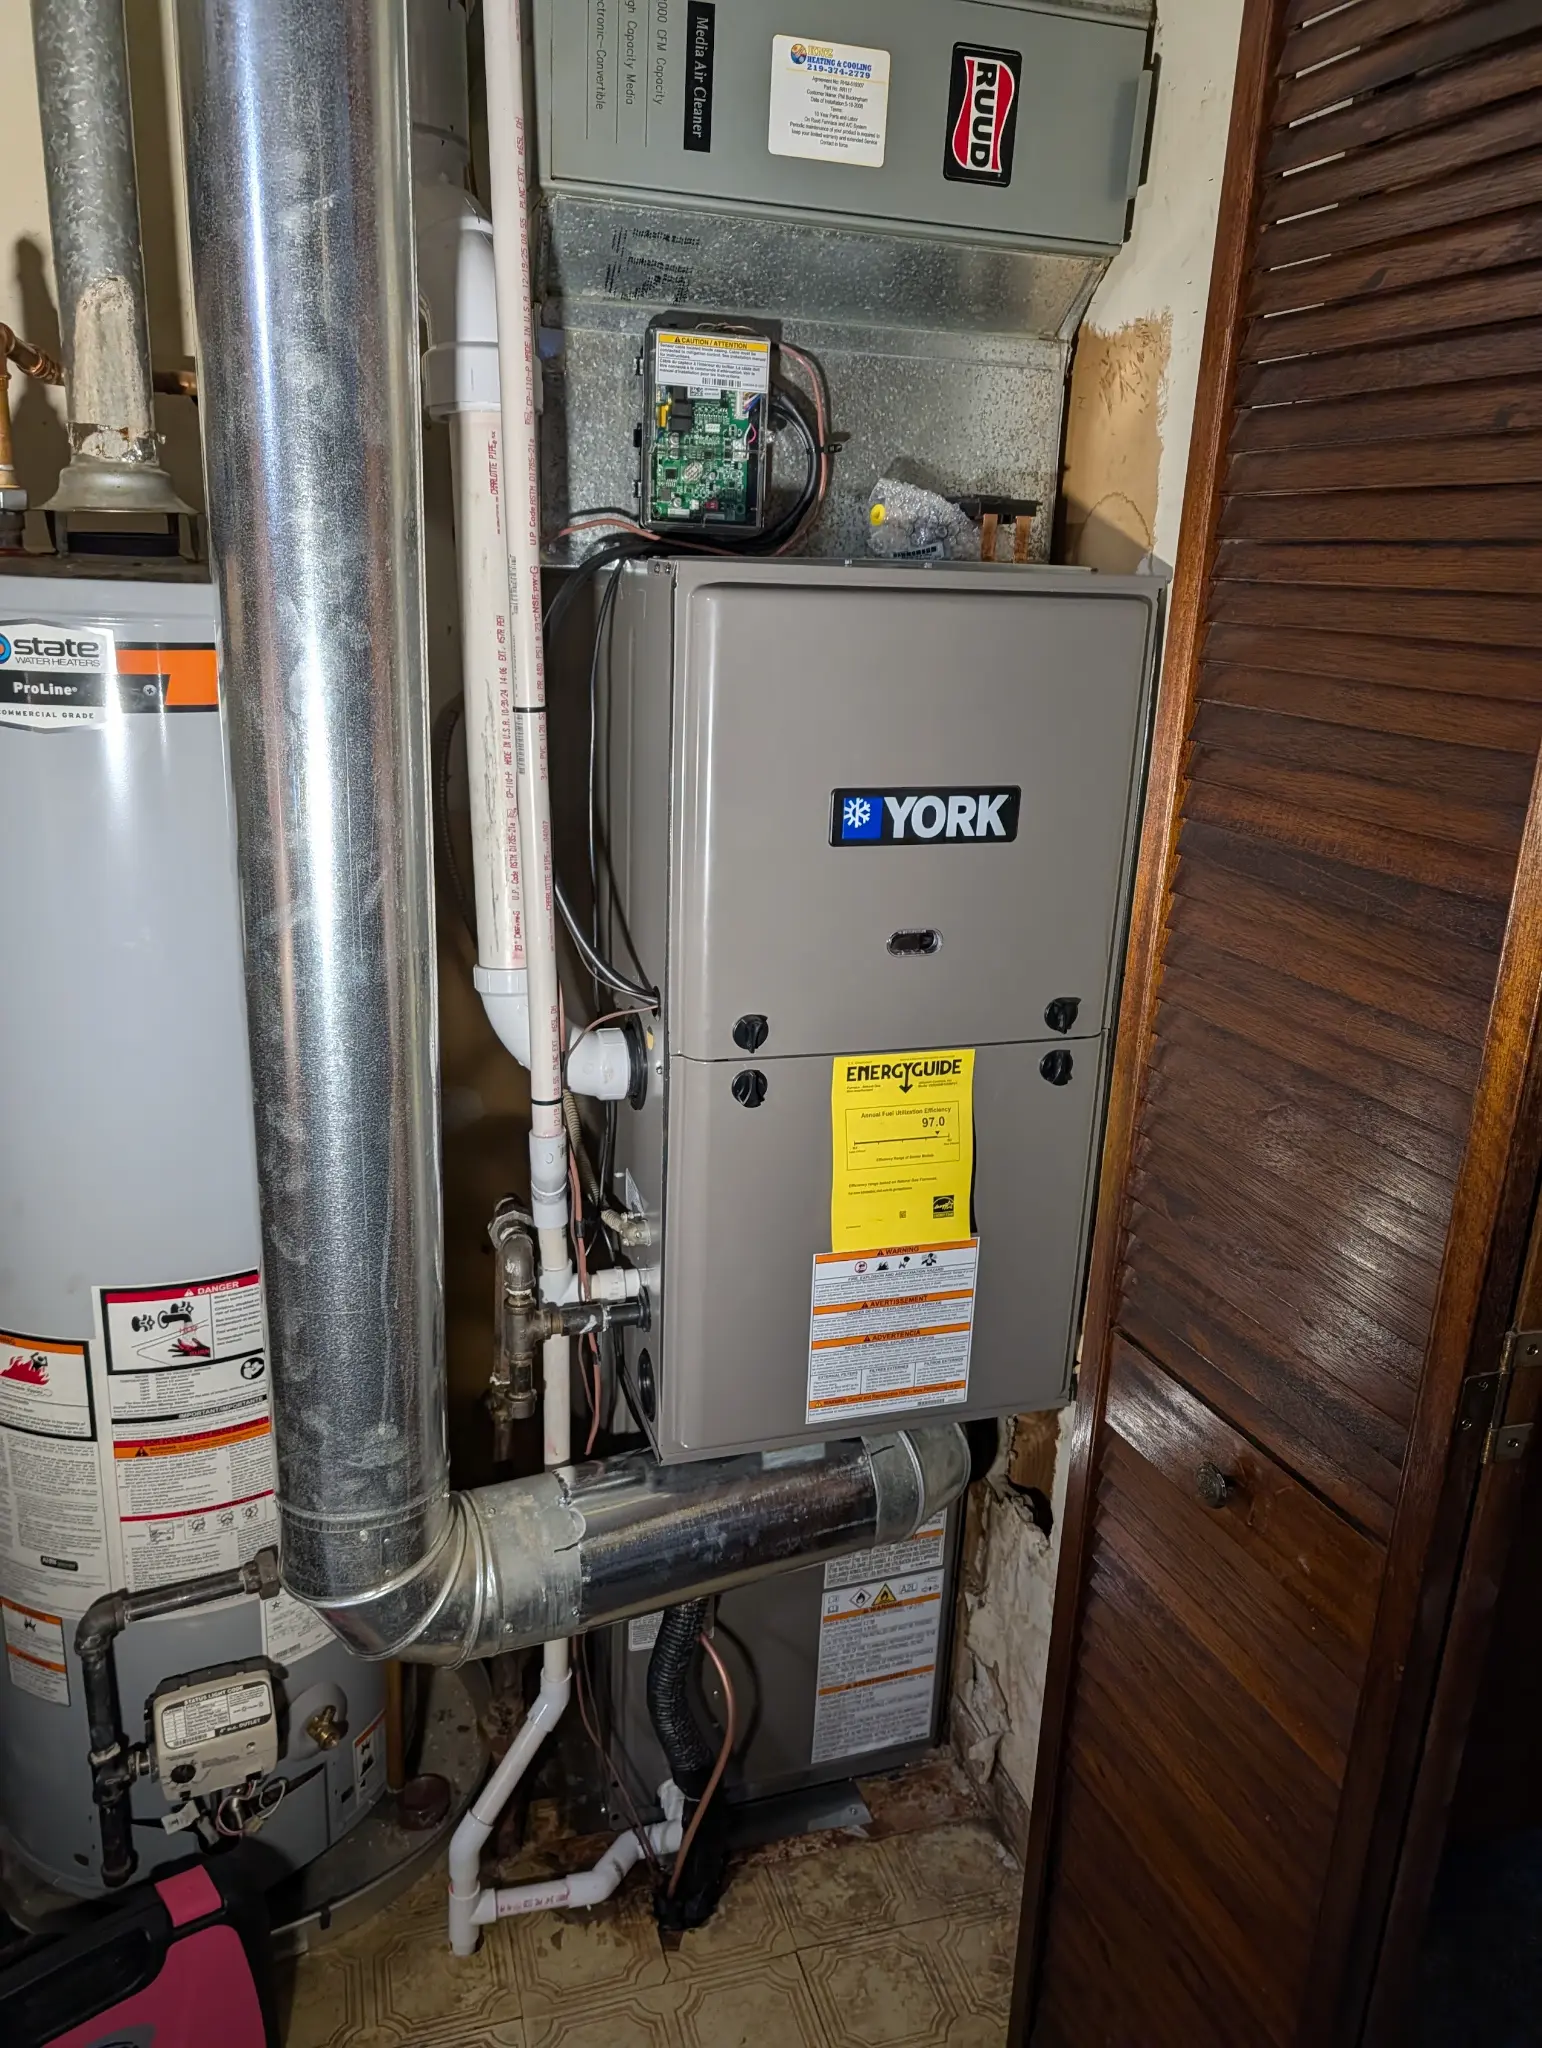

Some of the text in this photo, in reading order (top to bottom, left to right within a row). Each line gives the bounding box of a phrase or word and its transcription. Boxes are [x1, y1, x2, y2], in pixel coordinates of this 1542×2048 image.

[624, 20, 637, 69] Capacity
[653, 0, 668, 104] 000 CFM Capacity
[807, 56, 835, 66] HEATING
[843, 61, 871, 71] COOLING
[692, 16, 709, 138] Media Air Cleaner
[807, 64, 870, 79] 219-374-2779
[626, 73, 636, 104] Media
[970, 62, 998, 168] RUUD
[524, 326, 530, 336] IN
[524, 342, 532, 362] MADE
[713, 340, 747, 349] ATTENTION
[528, 486, 536, 506] ASTM
[528, 506, 536, 528] Code
[14, 637, 99, 658] state
[16, 657, 100, 668] WATER HEATERS
[538, 694, 544, 702] 40
[62, 712, 94, 720] GRADE
[884, 794, 1009, 838] YORK
[510, 871, 518, 884] Code
[847, 1059, 962, 1083] ENERGYGUIDE
[922, 1116, 945, 1127] 97.0
[886, 1246, 919, 1256] WARNING
[198, 1281, 240, 1294] DANGER
[870, 1295, 927, 1308] AVERTISSEMENT
[872, 1330, 921, 1341] ADVERTENCIA
[184, 1685, 243, 1704] STATUS LIGHT CODE
